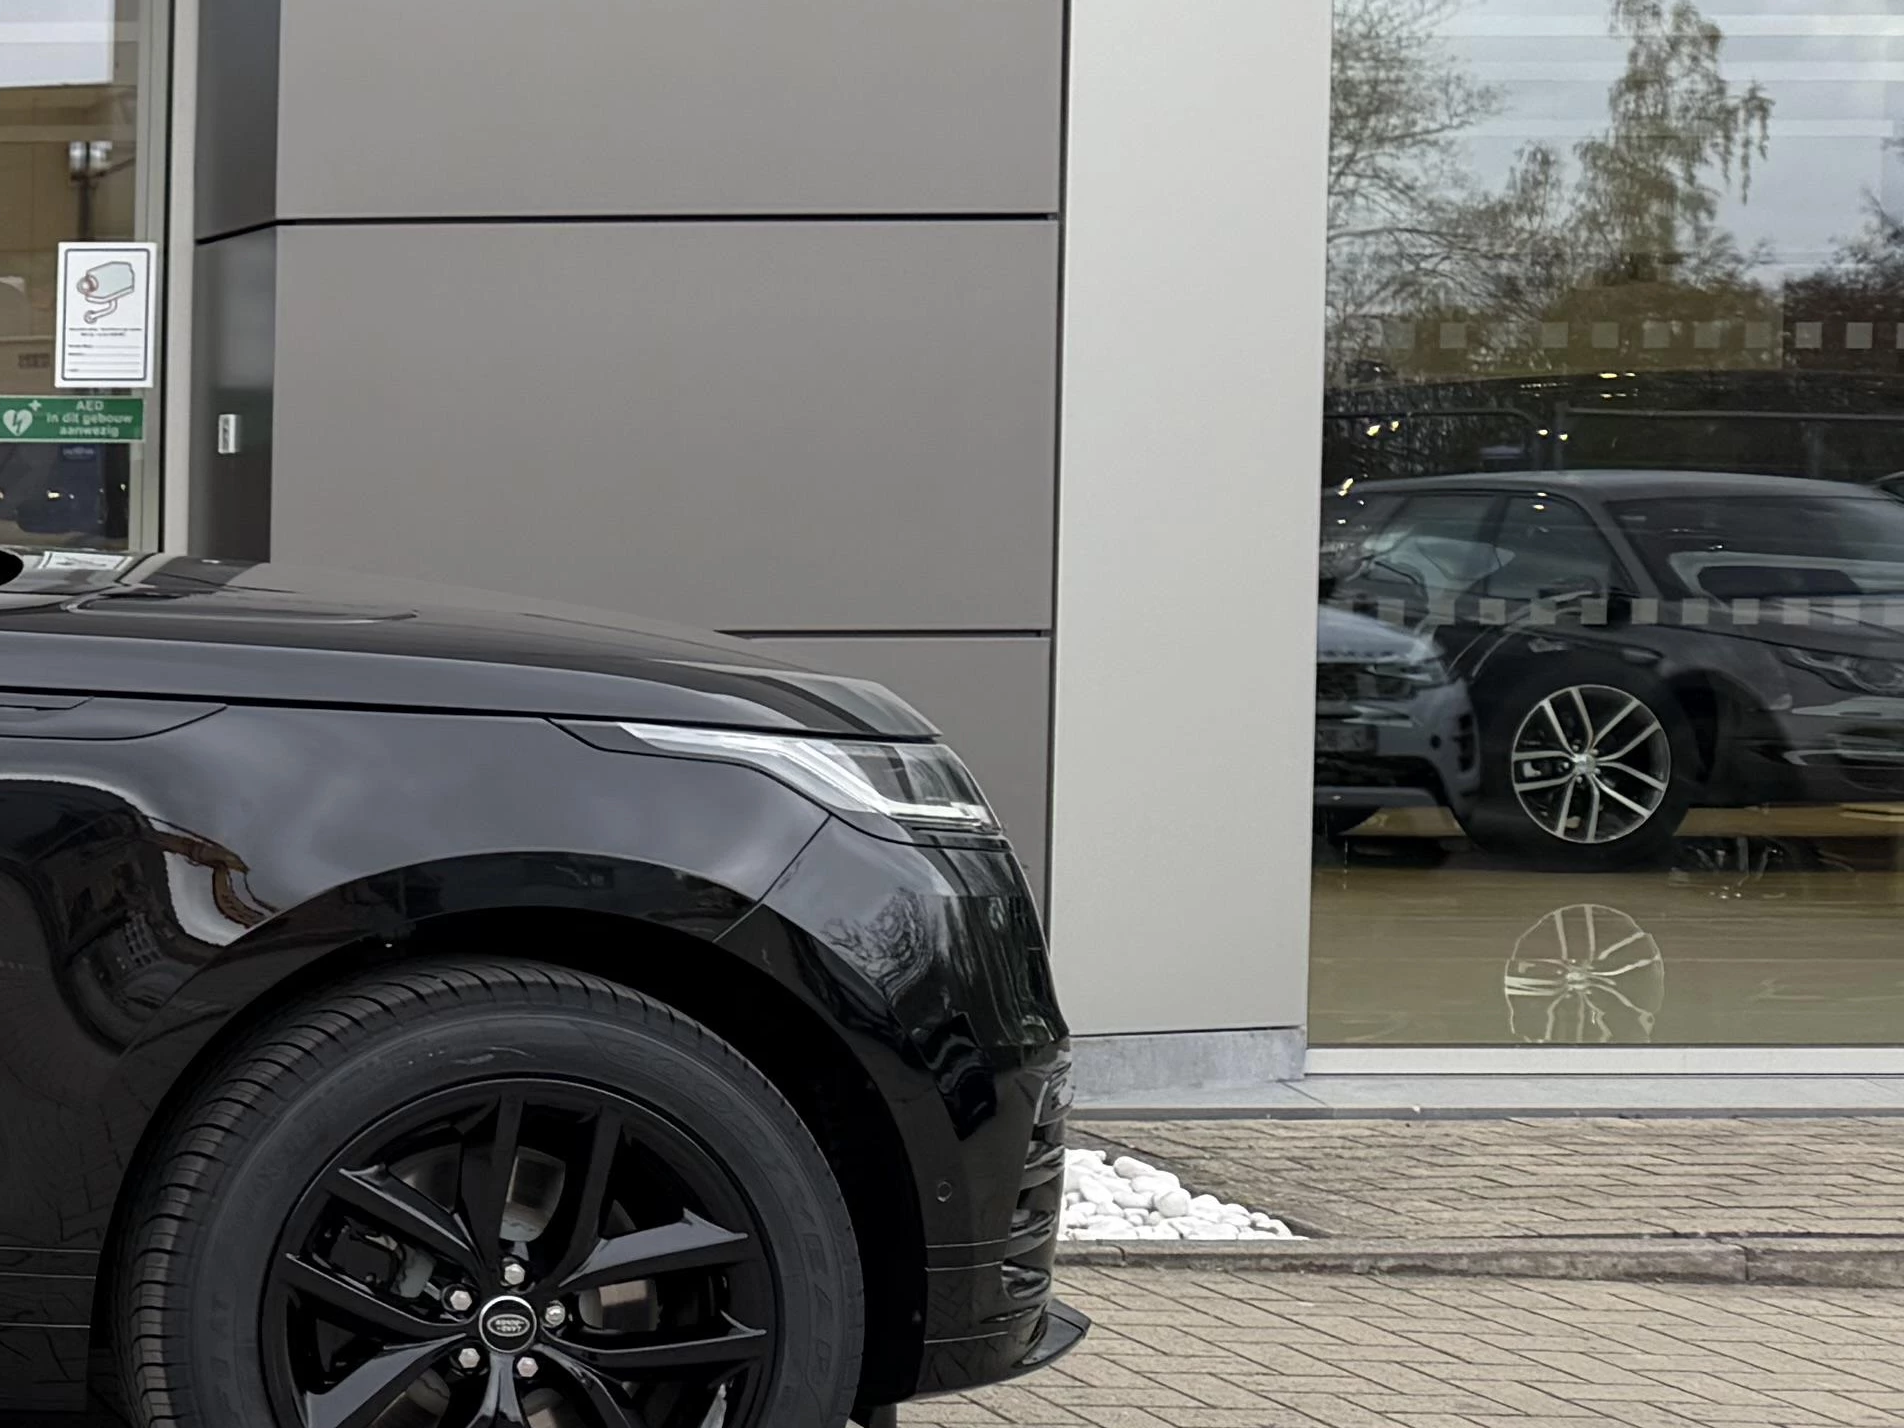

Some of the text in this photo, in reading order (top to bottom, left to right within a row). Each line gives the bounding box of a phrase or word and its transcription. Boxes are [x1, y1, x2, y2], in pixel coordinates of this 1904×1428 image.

[75, 400, 105, 412] AED
[82, 413, 134, 426] gebouw
[58, 425, 120, 438] aanwezig
